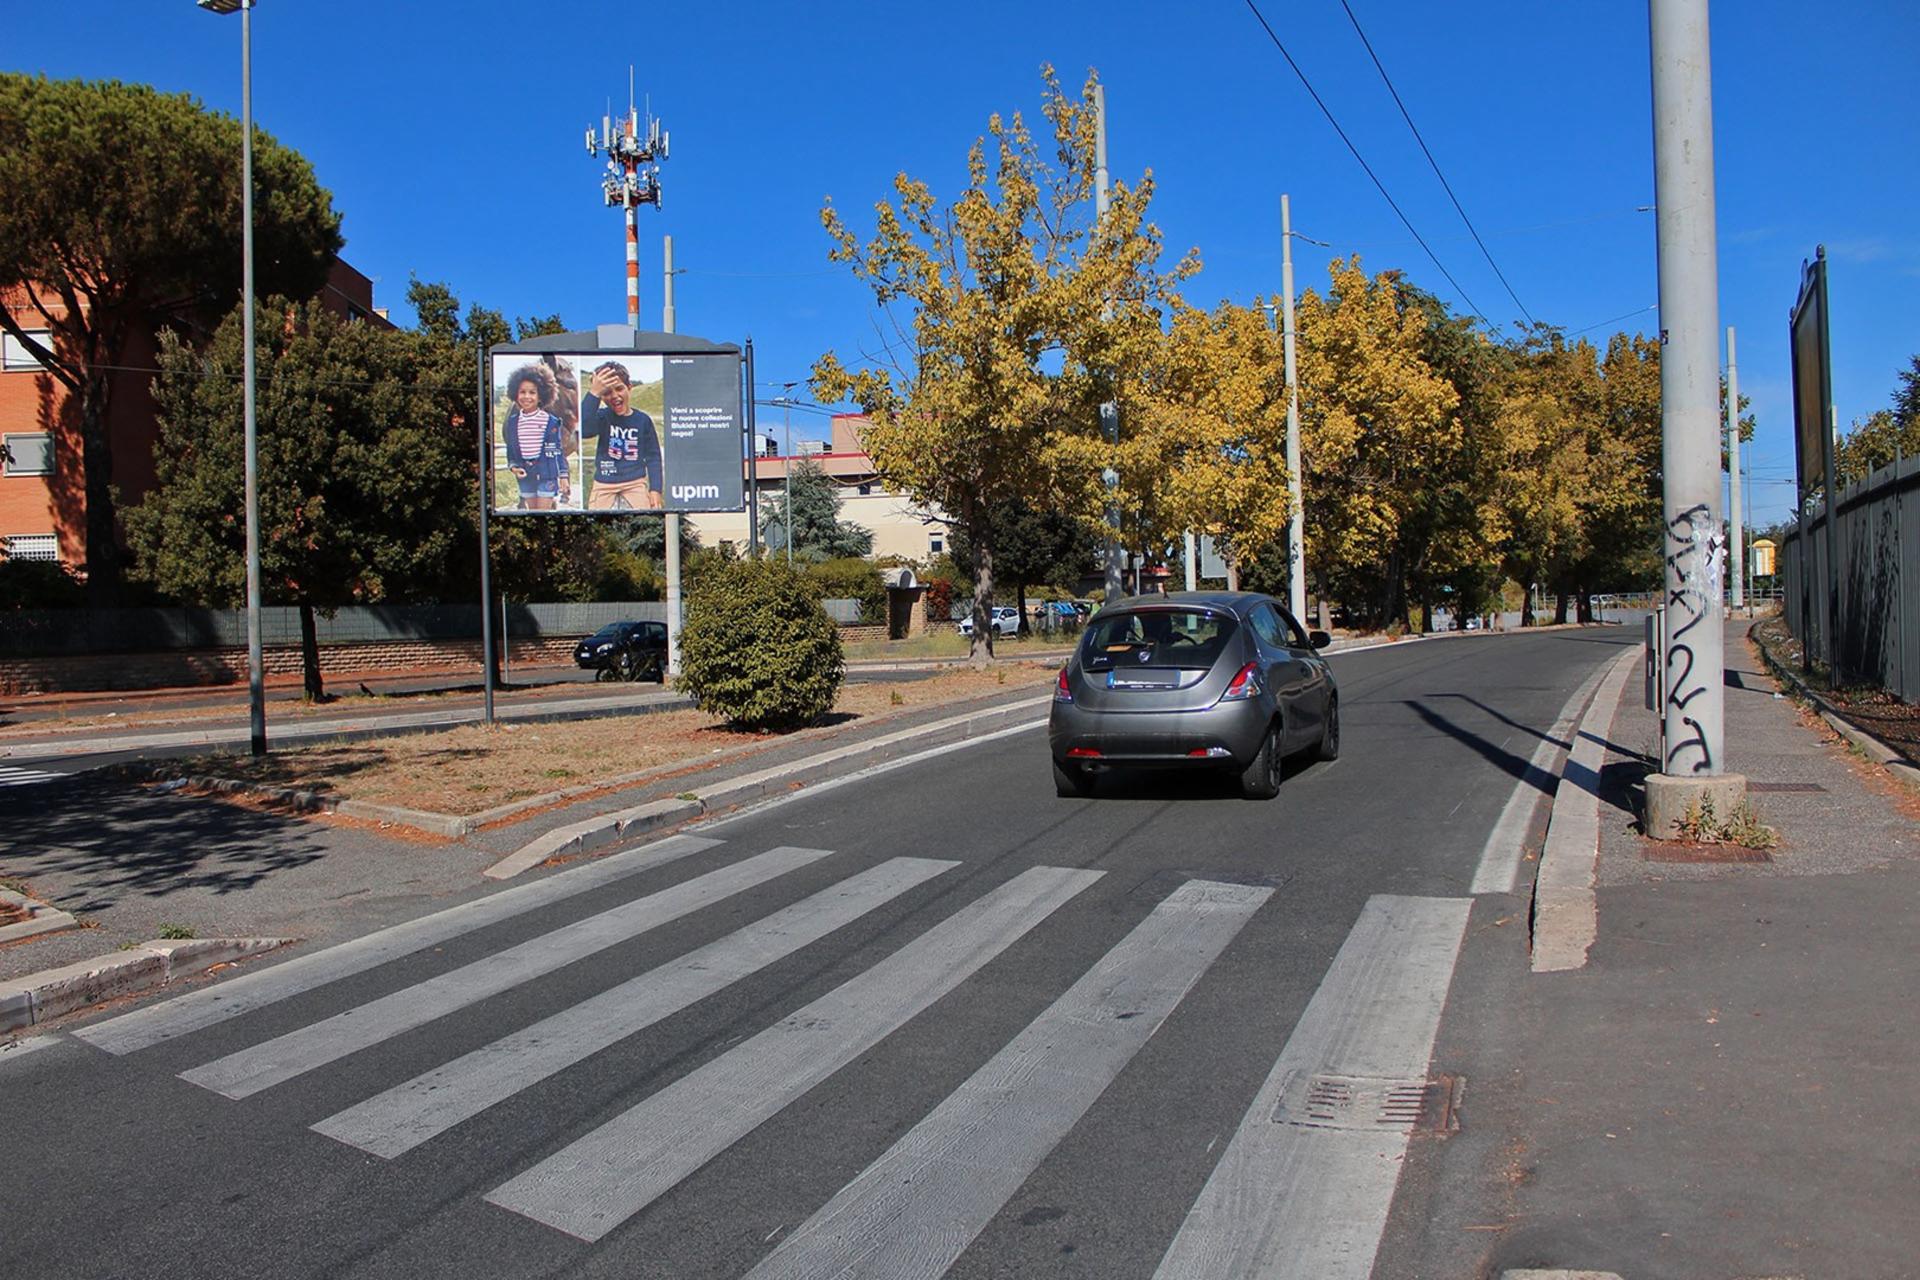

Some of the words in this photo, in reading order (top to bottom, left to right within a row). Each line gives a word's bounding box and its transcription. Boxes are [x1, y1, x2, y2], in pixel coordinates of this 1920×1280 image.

[609, 424, 639, 441] NYC
[671, 430, 694, 438] negozi
[608, 437, 639, 461] 65
[671, 484, 719, 502] upim
